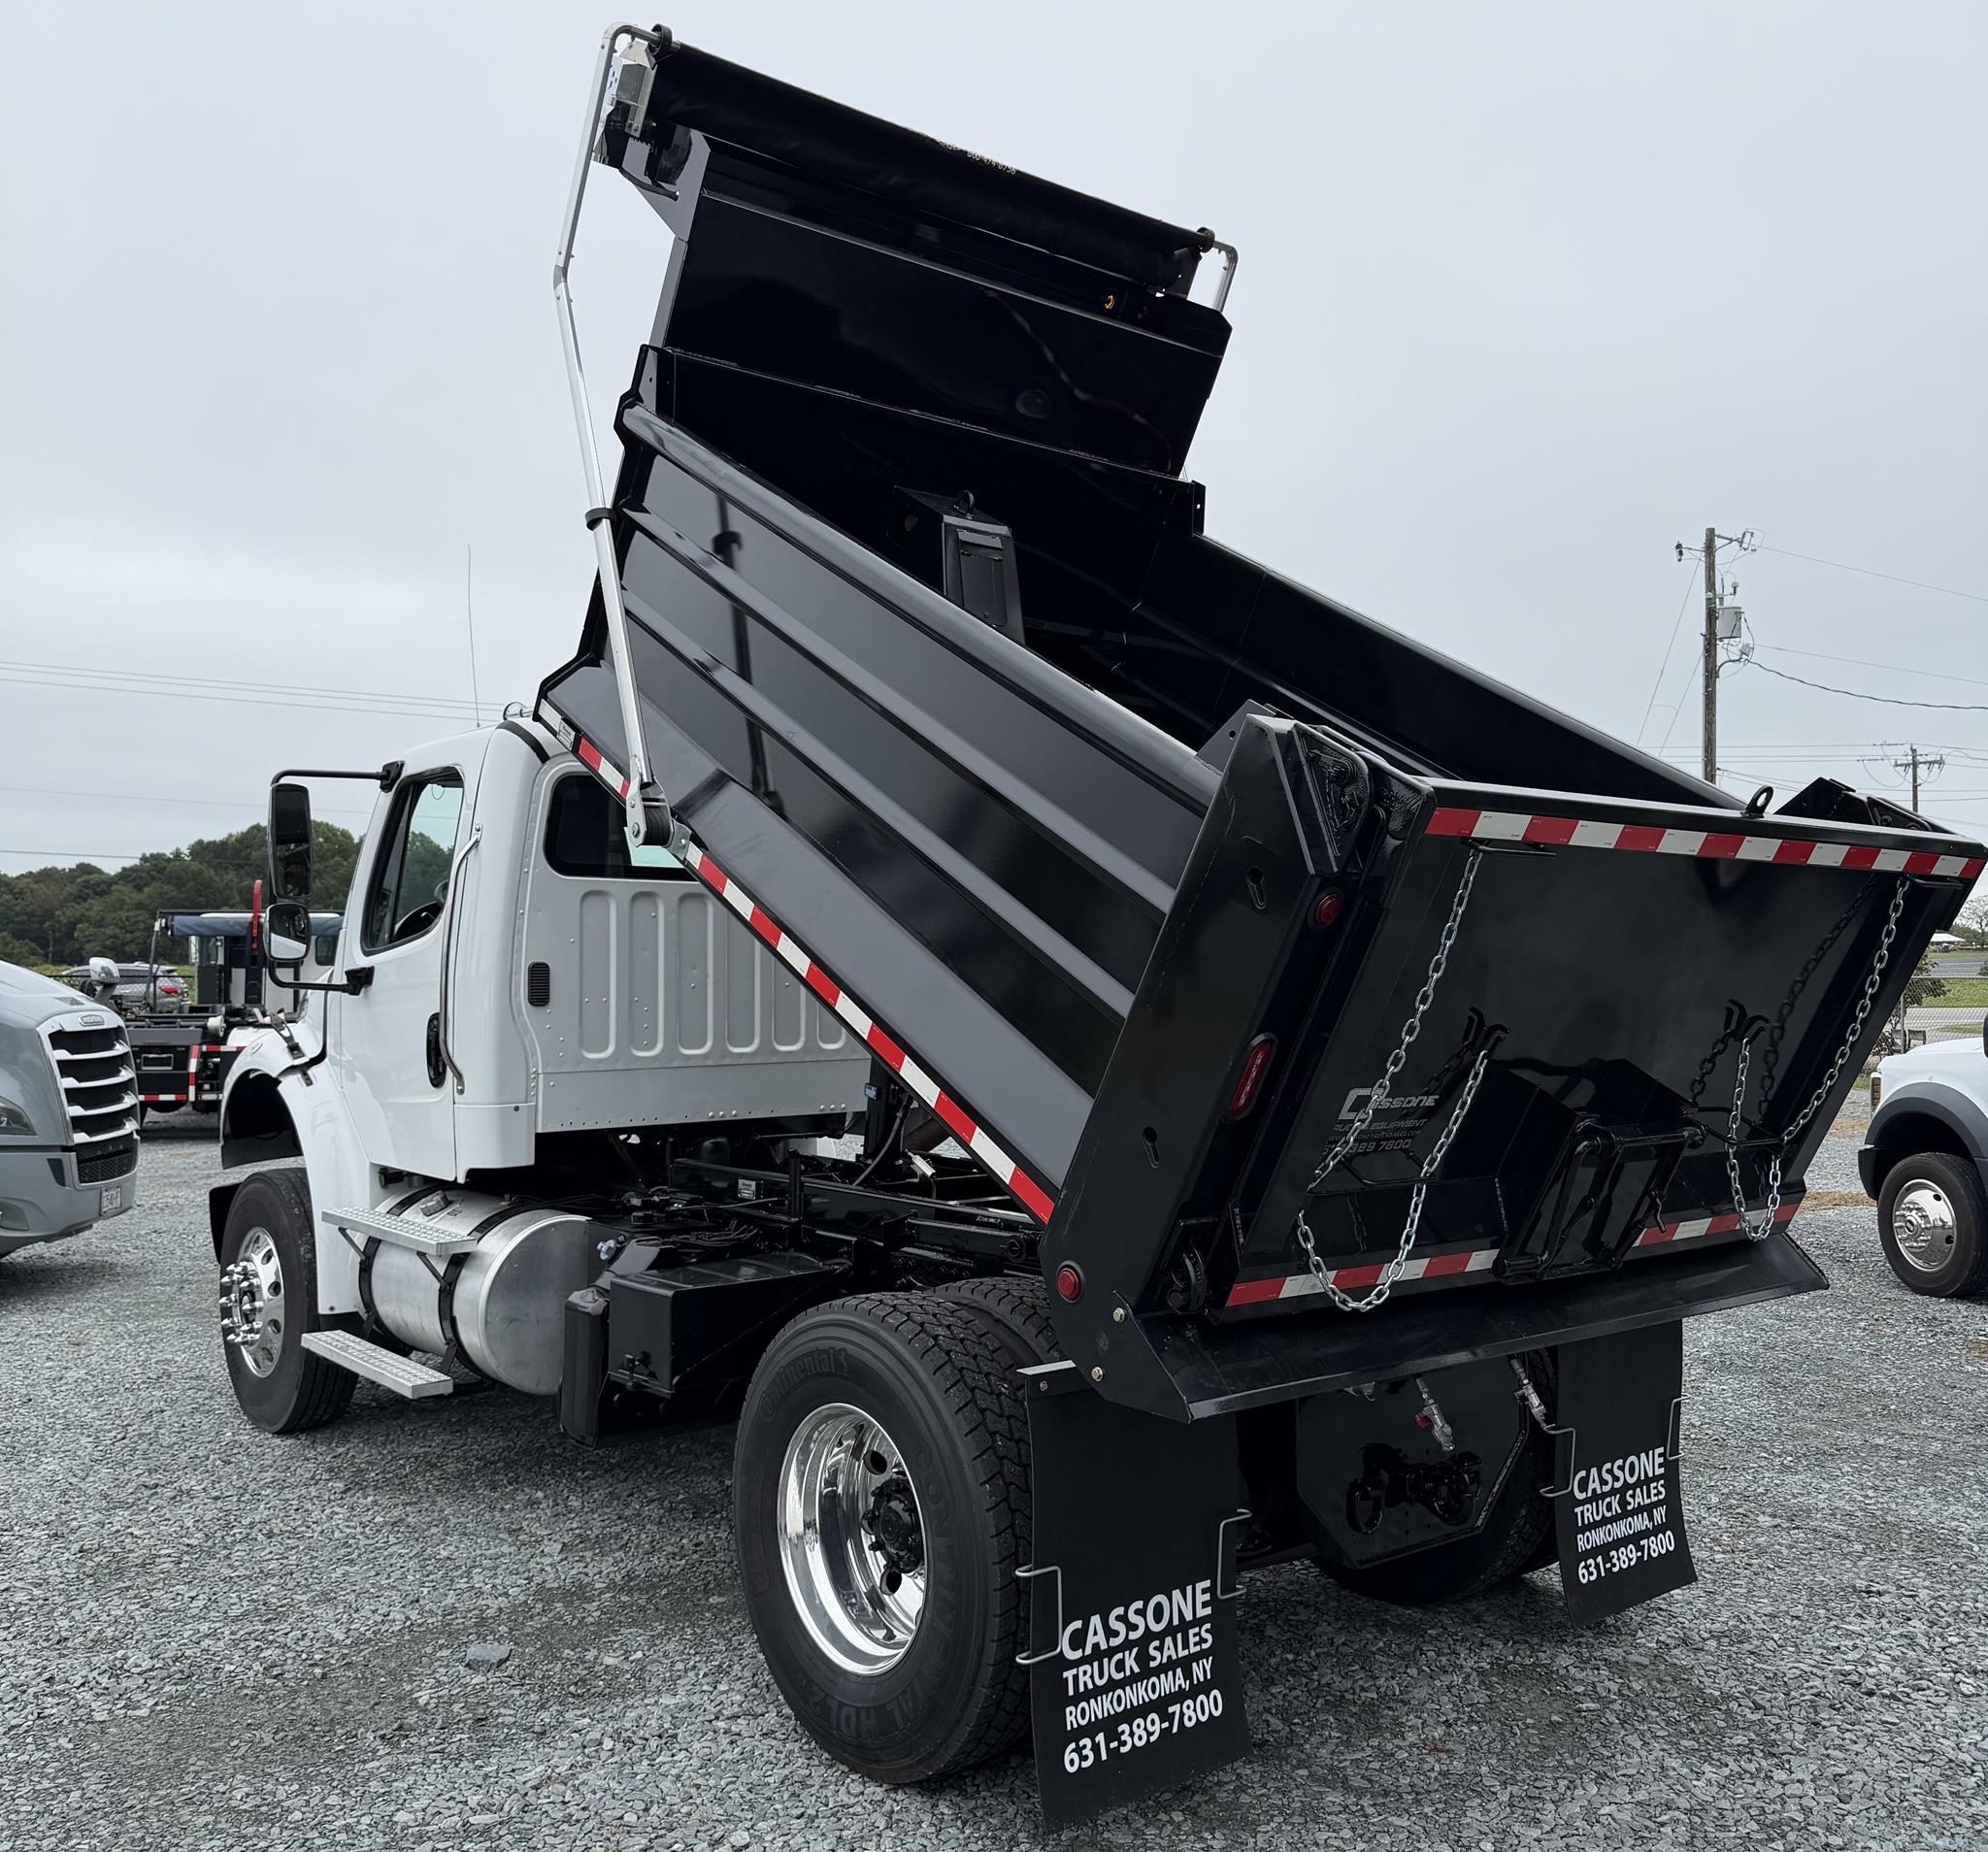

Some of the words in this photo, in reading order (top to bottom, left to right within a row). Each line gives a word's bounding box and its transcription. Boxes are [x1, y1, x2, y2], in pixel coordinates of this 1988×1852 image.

[1370, 1118, 1428, 1131] EQUIPMENT
[1377, 1139, 1413, 1151] 7800
[1573, 1446, 1666, 1501] CASSONE
[1574, 1493, 1622, 1527] TRUCK
[1626, 1479, 1667, 1511] SALES
[1576, 1512, 1653, 1553] RONKONKOMA,
[1653, 1505, 1668, 1527] NY
[1577, 1530, 1675, 1584] 631-389-7800
[1062, 1579, 1212, 1661] CASSONE
[1063, 1647, 1141, 1697] TRUCK
[1148, 1623, 1213, 1668] SALES
[1065, 1667, 1190, 1731] RONKONKOMA,
[1192, 1656, 1213, 1685] NY
[1064, 1689, 1223, 1773] 631-389-7800
